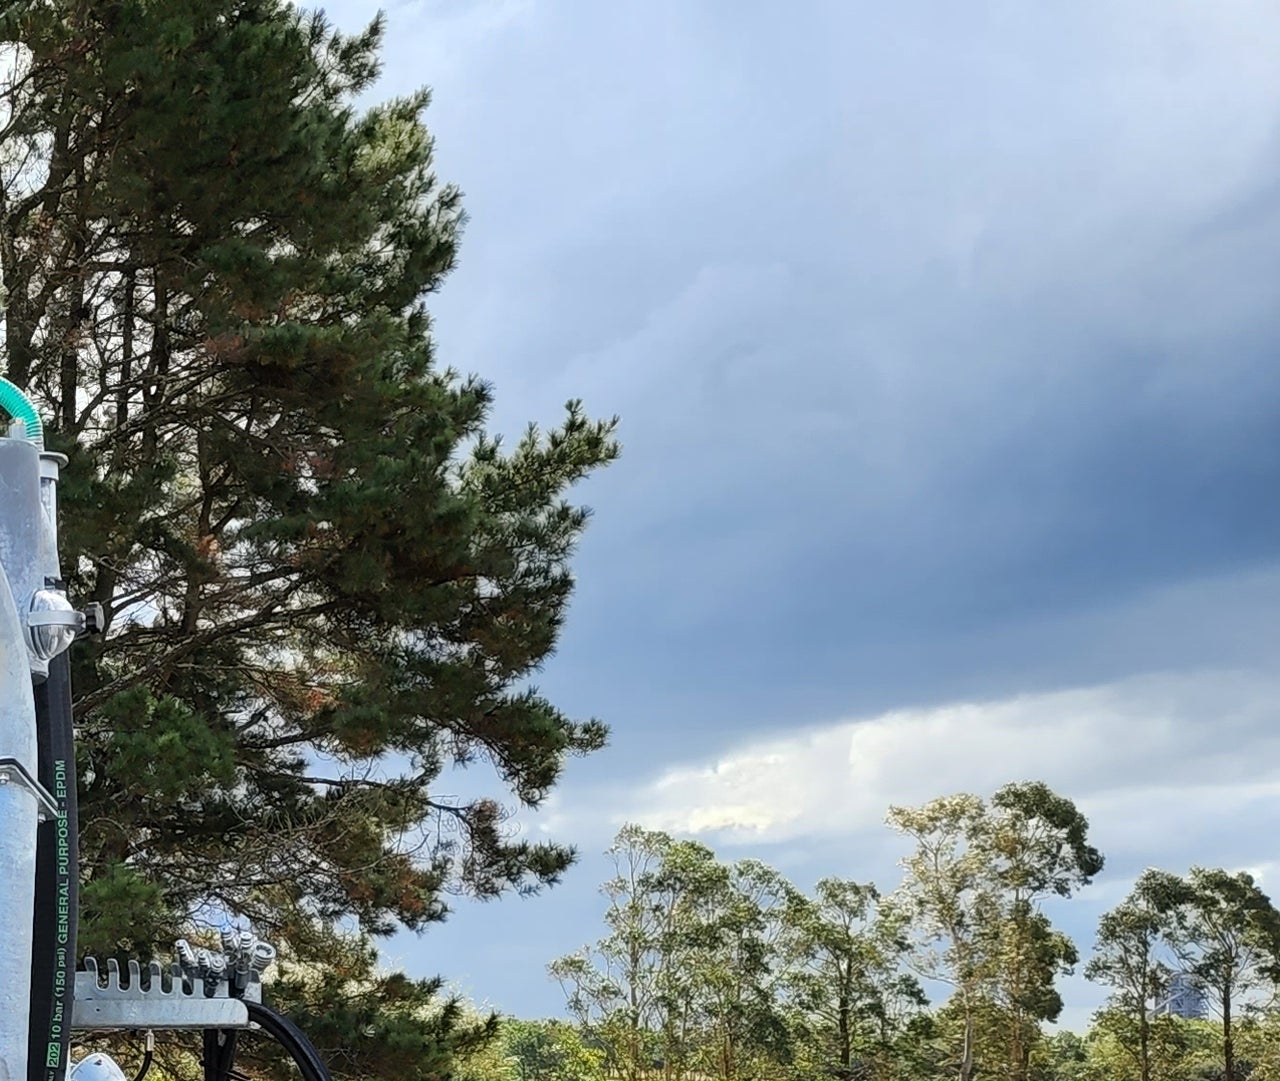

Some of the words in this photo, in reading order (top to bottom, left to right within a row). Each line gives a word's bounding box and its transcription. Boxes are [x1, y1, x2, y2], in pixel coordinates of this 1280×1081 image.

[55, 760, 68, 798] EPDM
[57, 810, 70, 875] PURPOSE
[57, 879, 70, 944] GENERAL
[56, 948, 68, 968] psi)
[54, 970, 66, 997] (150
[52, 1001, 64, 1022] bar
[51, 1024, 61, 1039] 10
[48, 1043, 59, 1066] 202
